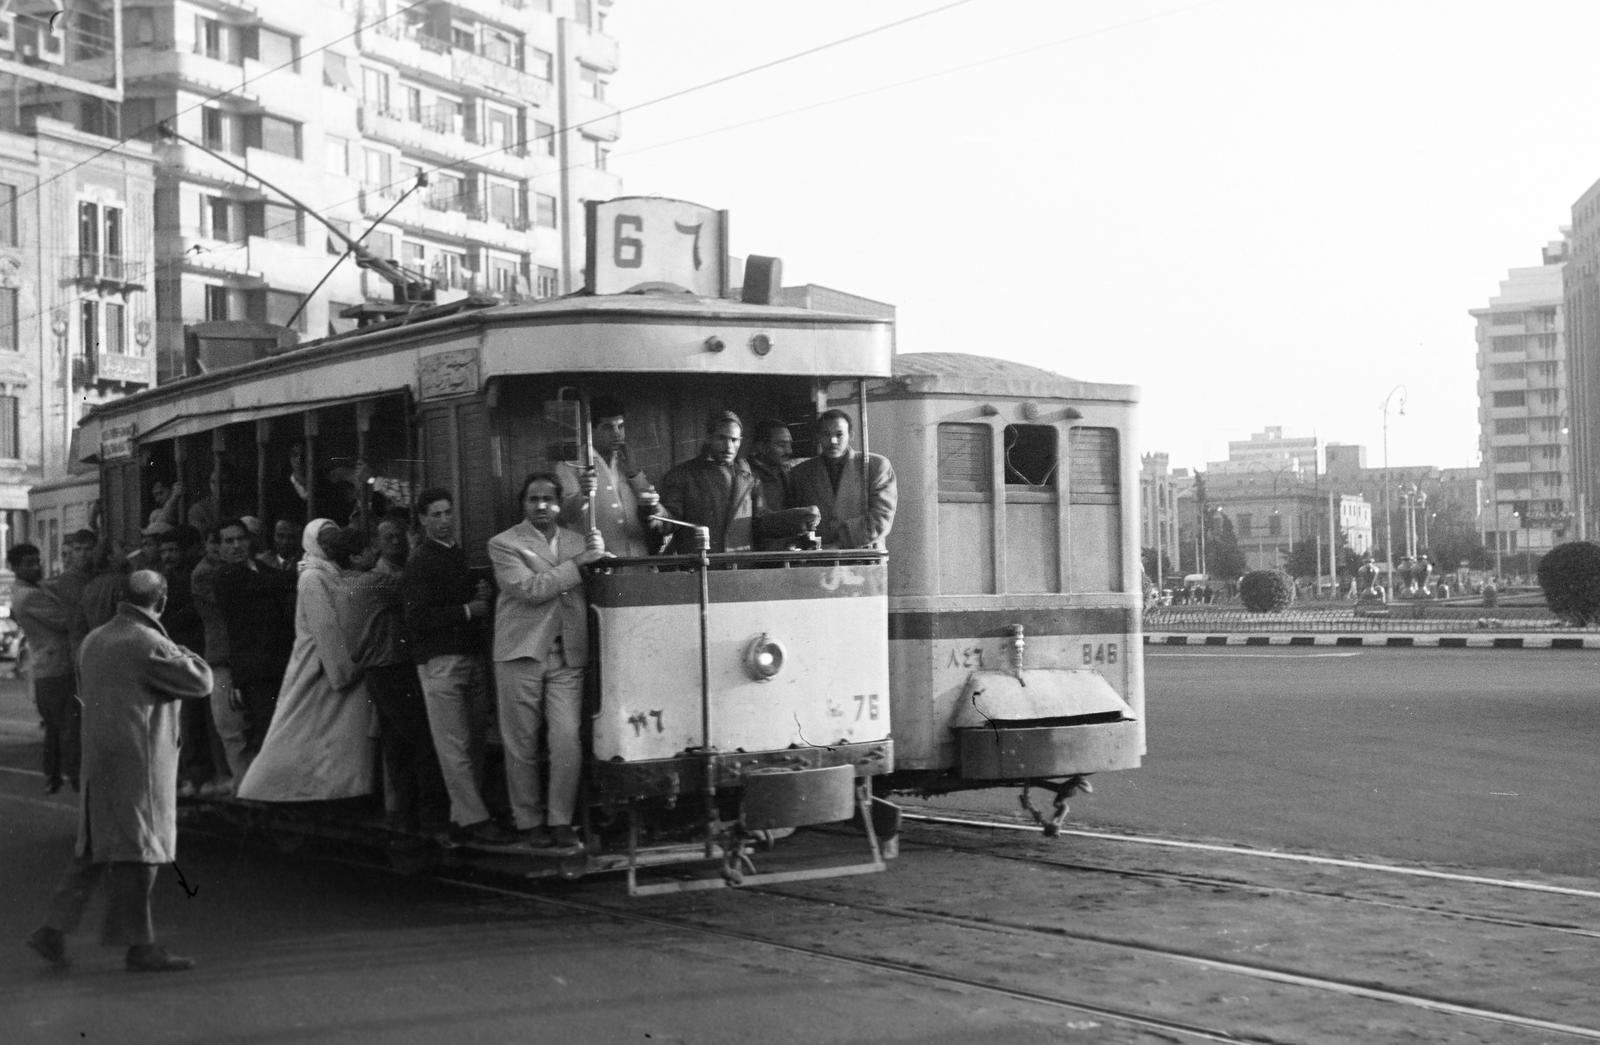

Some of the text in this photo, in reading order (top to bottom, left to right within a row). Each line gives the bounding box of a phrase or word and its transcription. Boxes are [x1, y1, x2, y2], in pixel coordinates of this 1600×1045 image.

[614, 214, 643, 268] 6
[674, 220, 704, 271] ٦
[947, 647, 984, 668] ٨٤٦
[1082, 643, 1118, 665] 846
